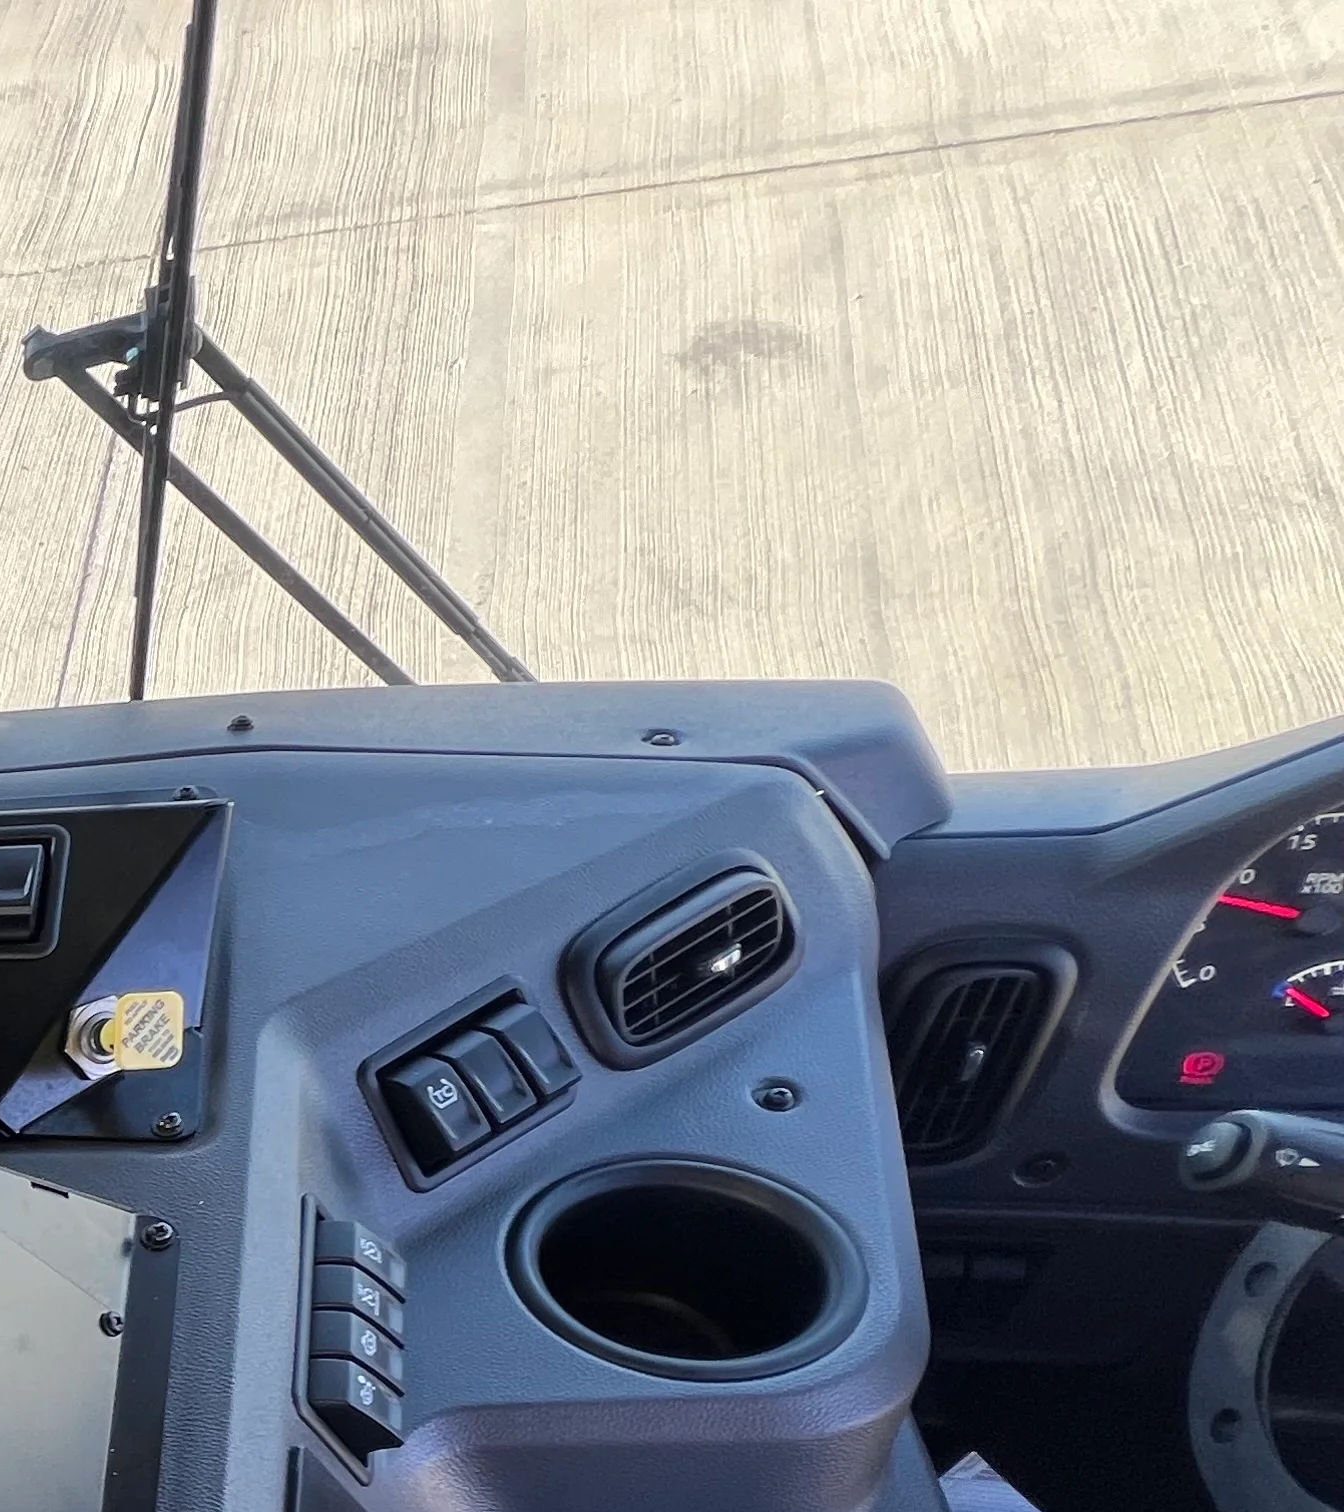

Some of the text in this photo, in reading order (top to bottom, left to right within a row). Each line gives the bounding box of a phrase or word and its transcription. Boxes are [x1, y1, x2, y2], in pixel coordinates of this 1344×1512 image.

[1286, 833, 1318, 851] 15
[1238, 868, 1257, 884] 0
[121, 999, 165, 1049] PARKING
[134, 1013, 171, 1054] BRAKE
